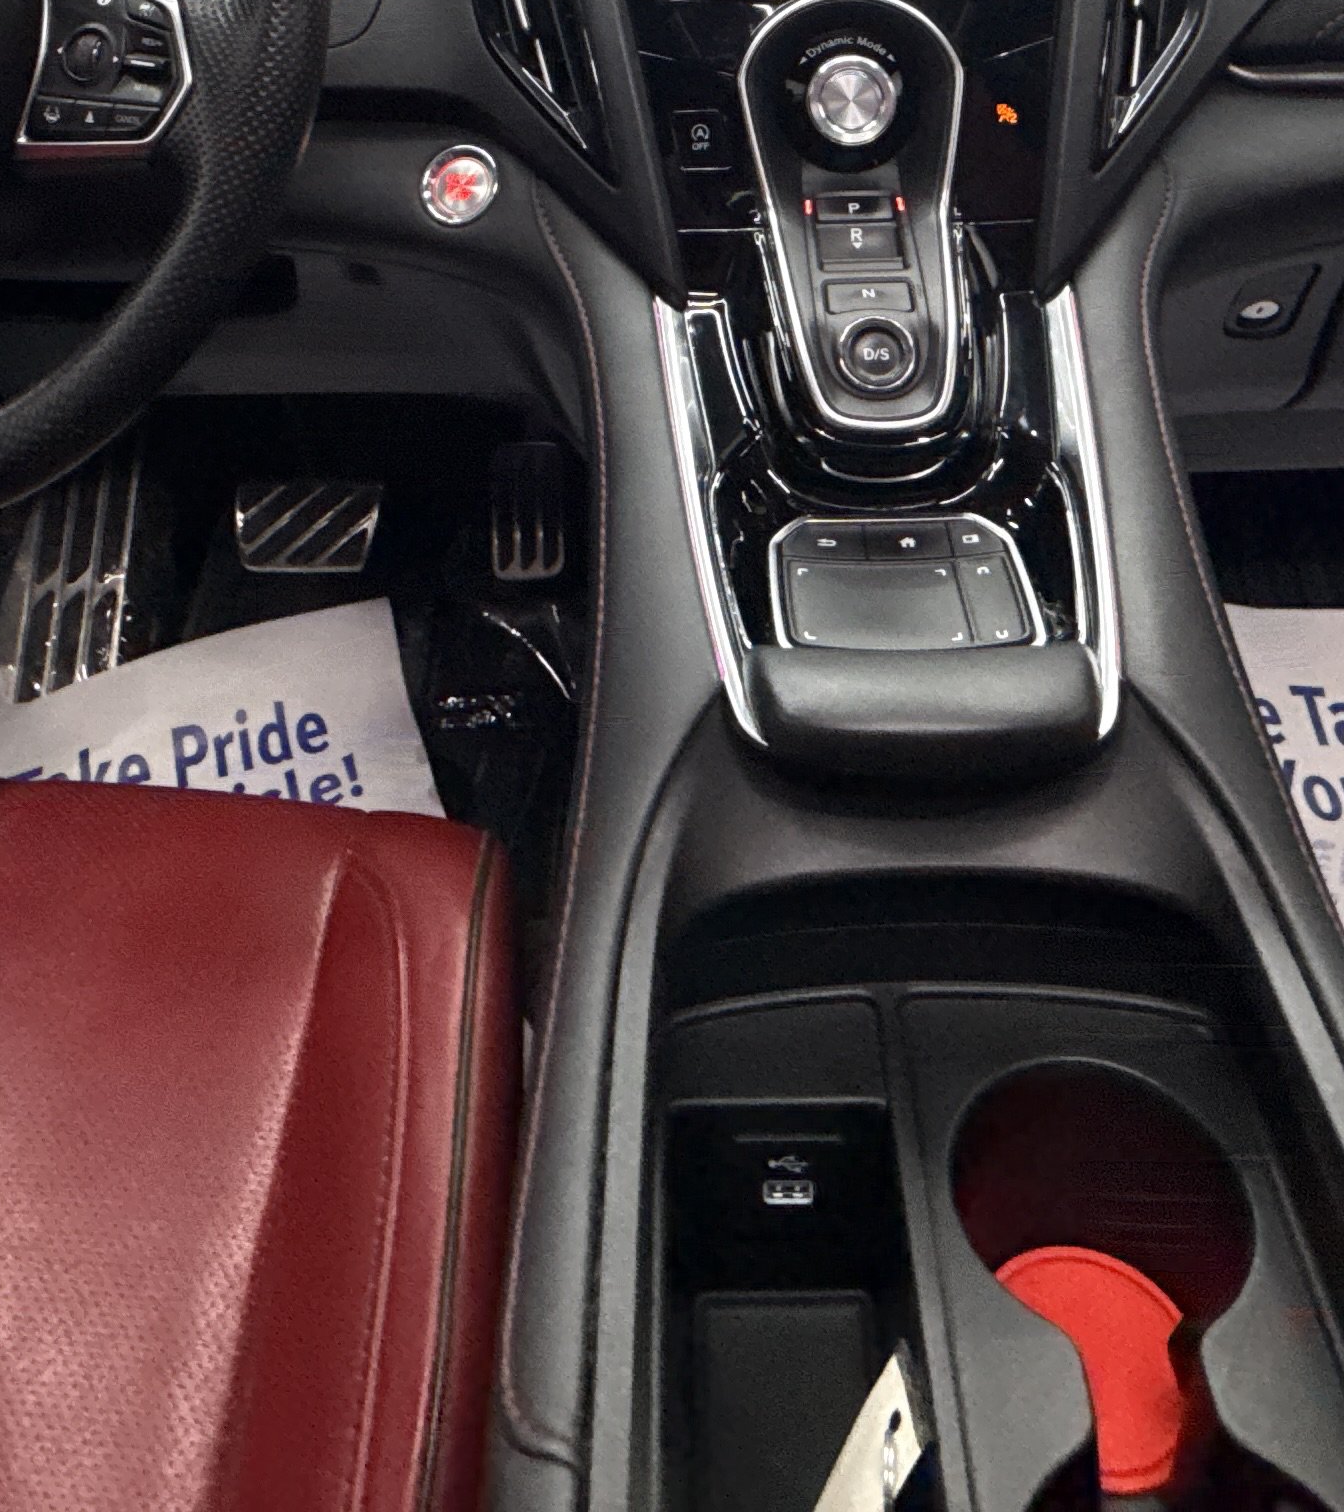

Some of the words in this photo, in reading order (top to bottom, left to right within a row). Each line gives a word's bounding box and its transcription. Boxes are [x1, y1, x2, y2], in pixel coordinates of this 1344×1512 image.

[804, 35, 854, 59] Dynamic
[856, 37, 888, 56] Mode
[691, 142, 710, 151] OFF
[848, 202, 861, 215] P
[850, 228, 863, 243] R
[862, 288, 876, 299] N
[862, 347, 890, 361] D/S
[170, 700, 330, 789] Pride
